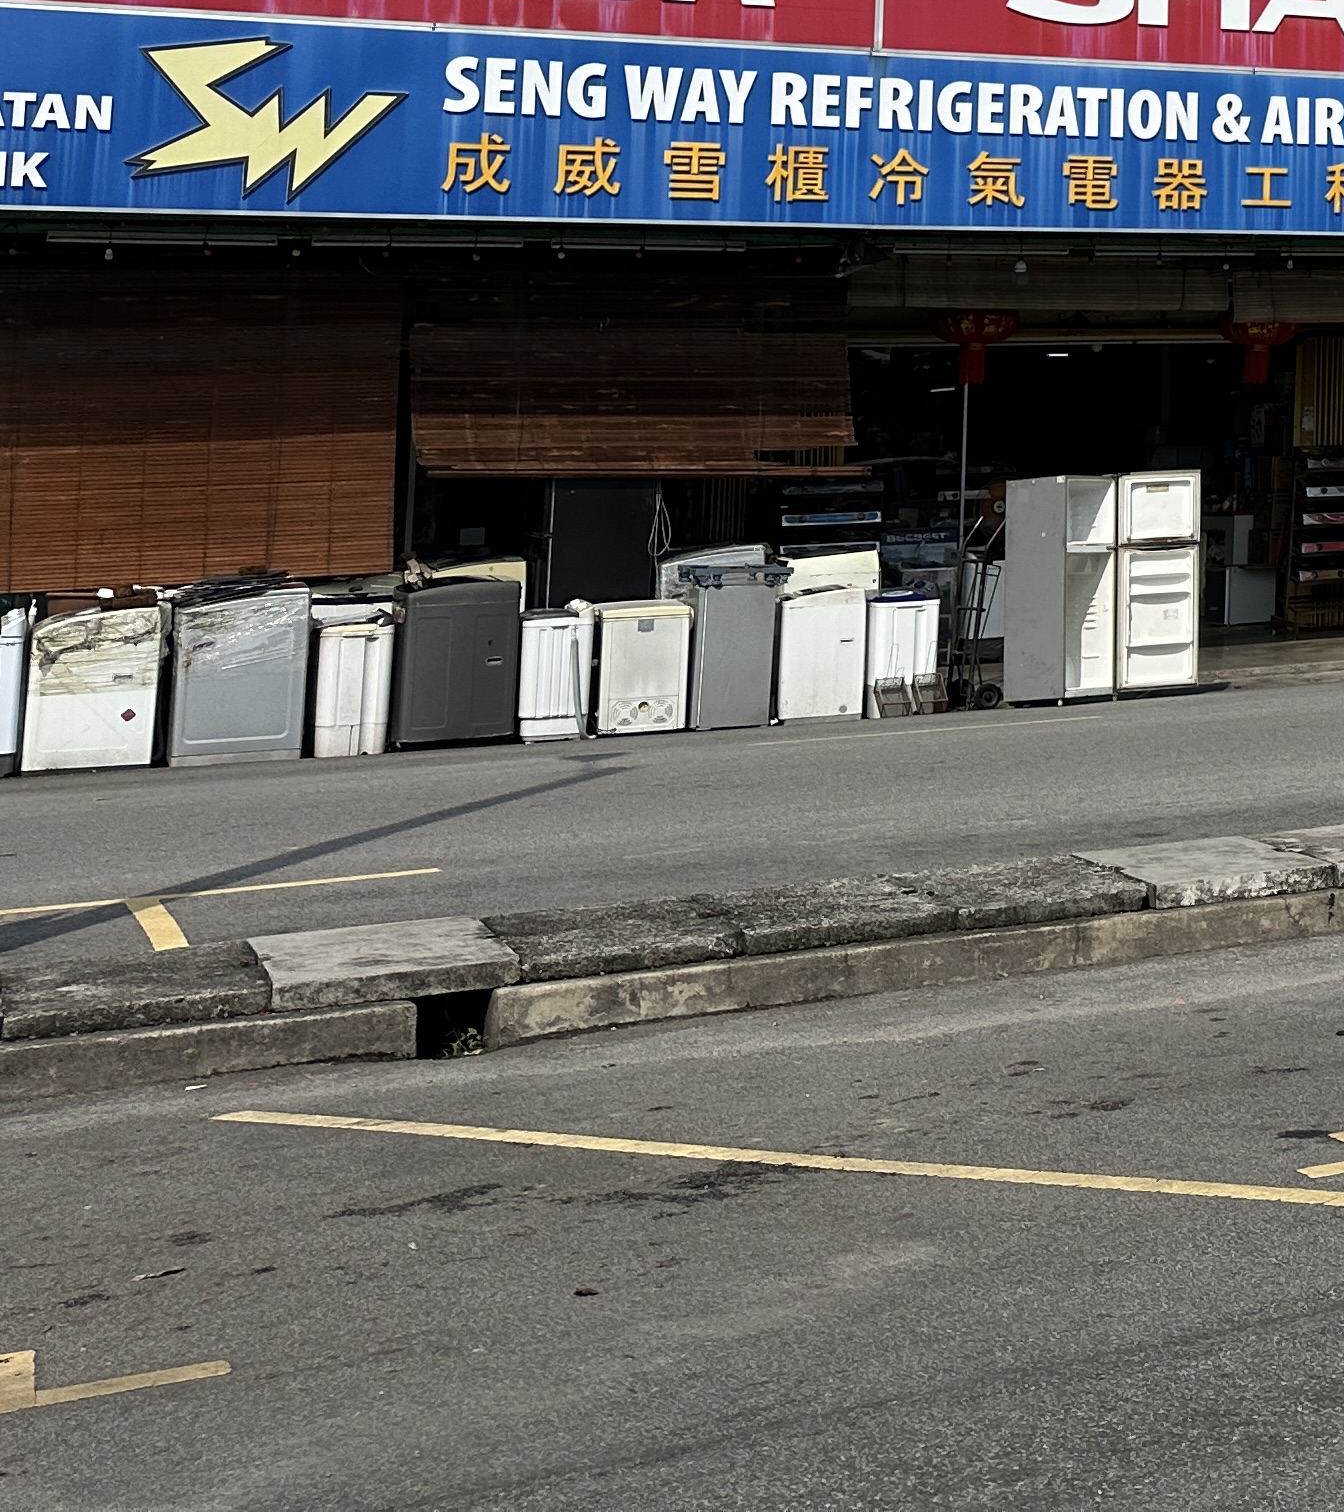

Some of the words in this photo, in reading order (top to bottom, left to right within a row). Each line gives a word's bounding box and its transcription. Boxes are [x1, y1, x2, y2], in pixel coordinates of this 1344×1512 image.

[0, 91, 113, 131] TAN
[443, 56, 607, 118] SENG
[624, 65, 757, 124] WAY
[771, 72, 1199, 142] REFRIGERATION
[1212, 93, 1251, 143] &
[1261, 96, 1344, 146] AIR
